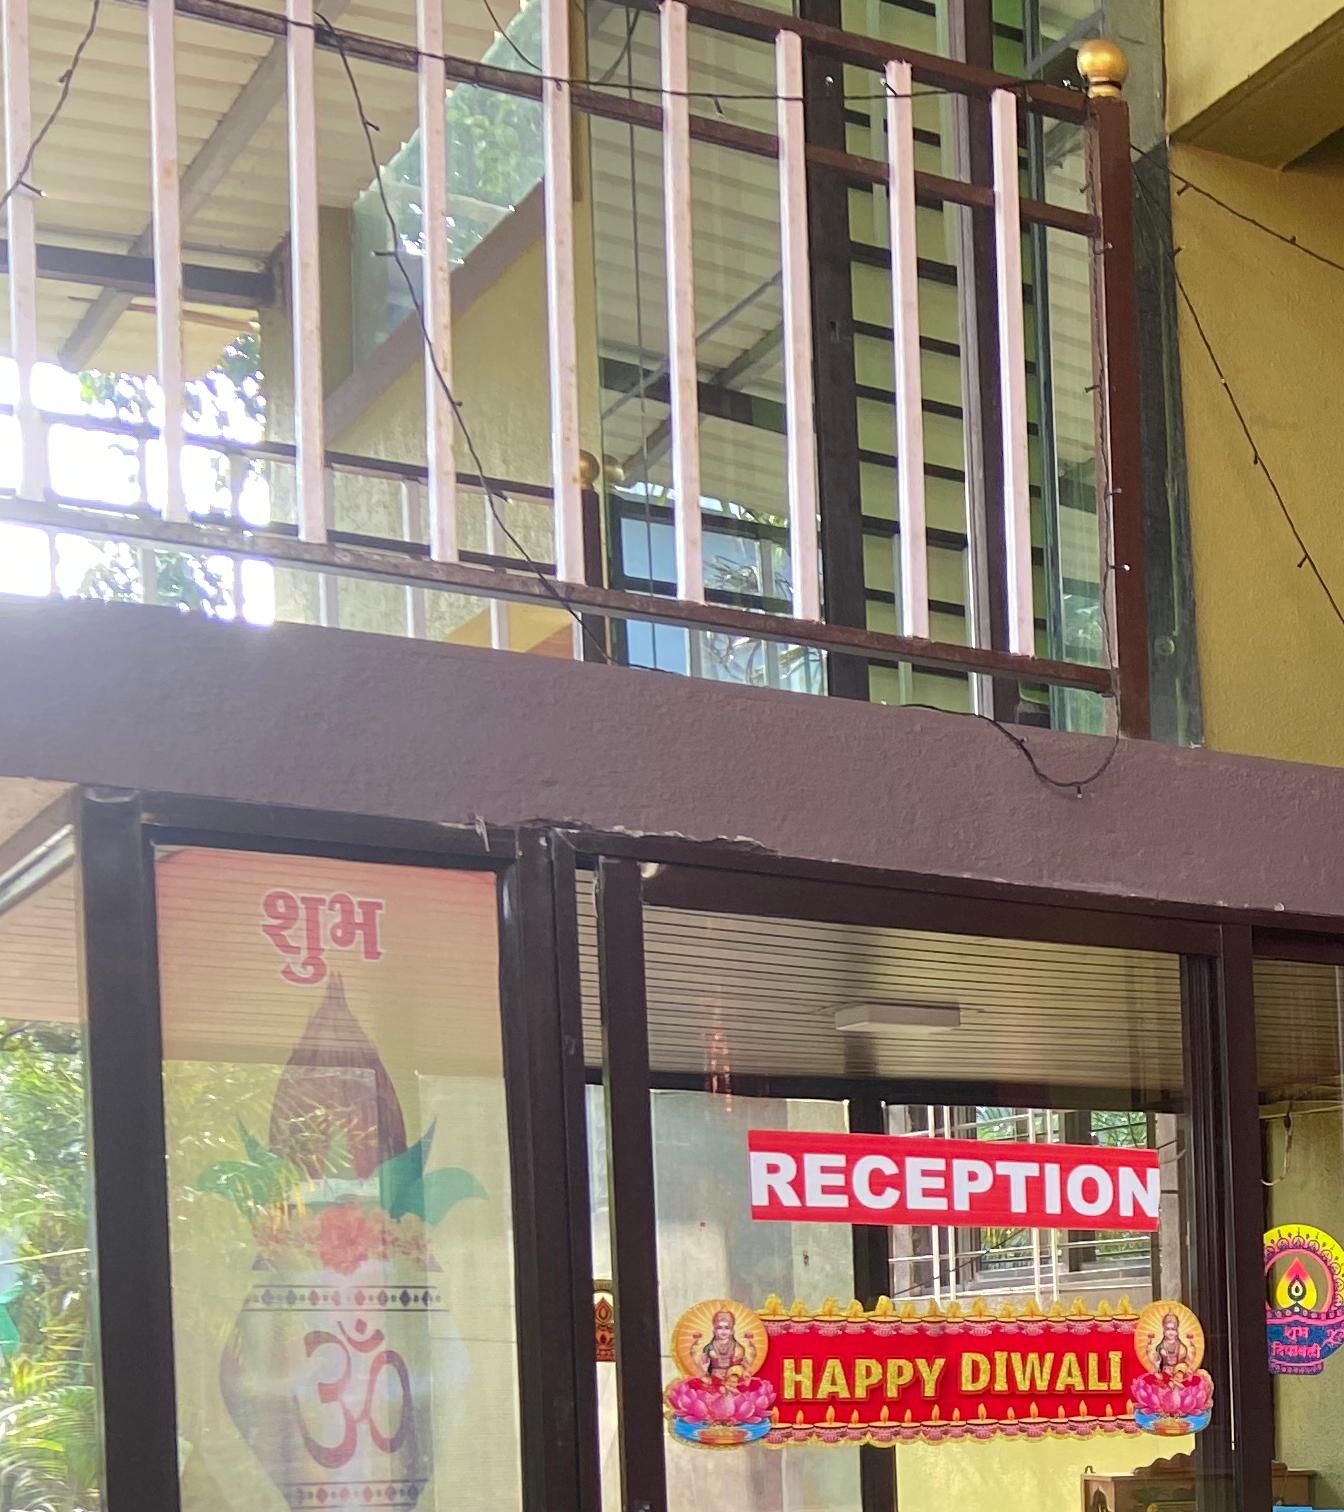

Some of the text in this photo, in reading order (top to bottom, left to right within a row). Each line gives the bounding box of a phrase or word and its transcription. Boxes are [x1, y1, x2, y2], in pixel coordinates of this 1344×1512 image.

[260, 889, 384, 986] शुभ
[749, 1151, 1160, 1219] RECEPTION
[782, 1349, 1123, 1401] HAPPY DIWALI
